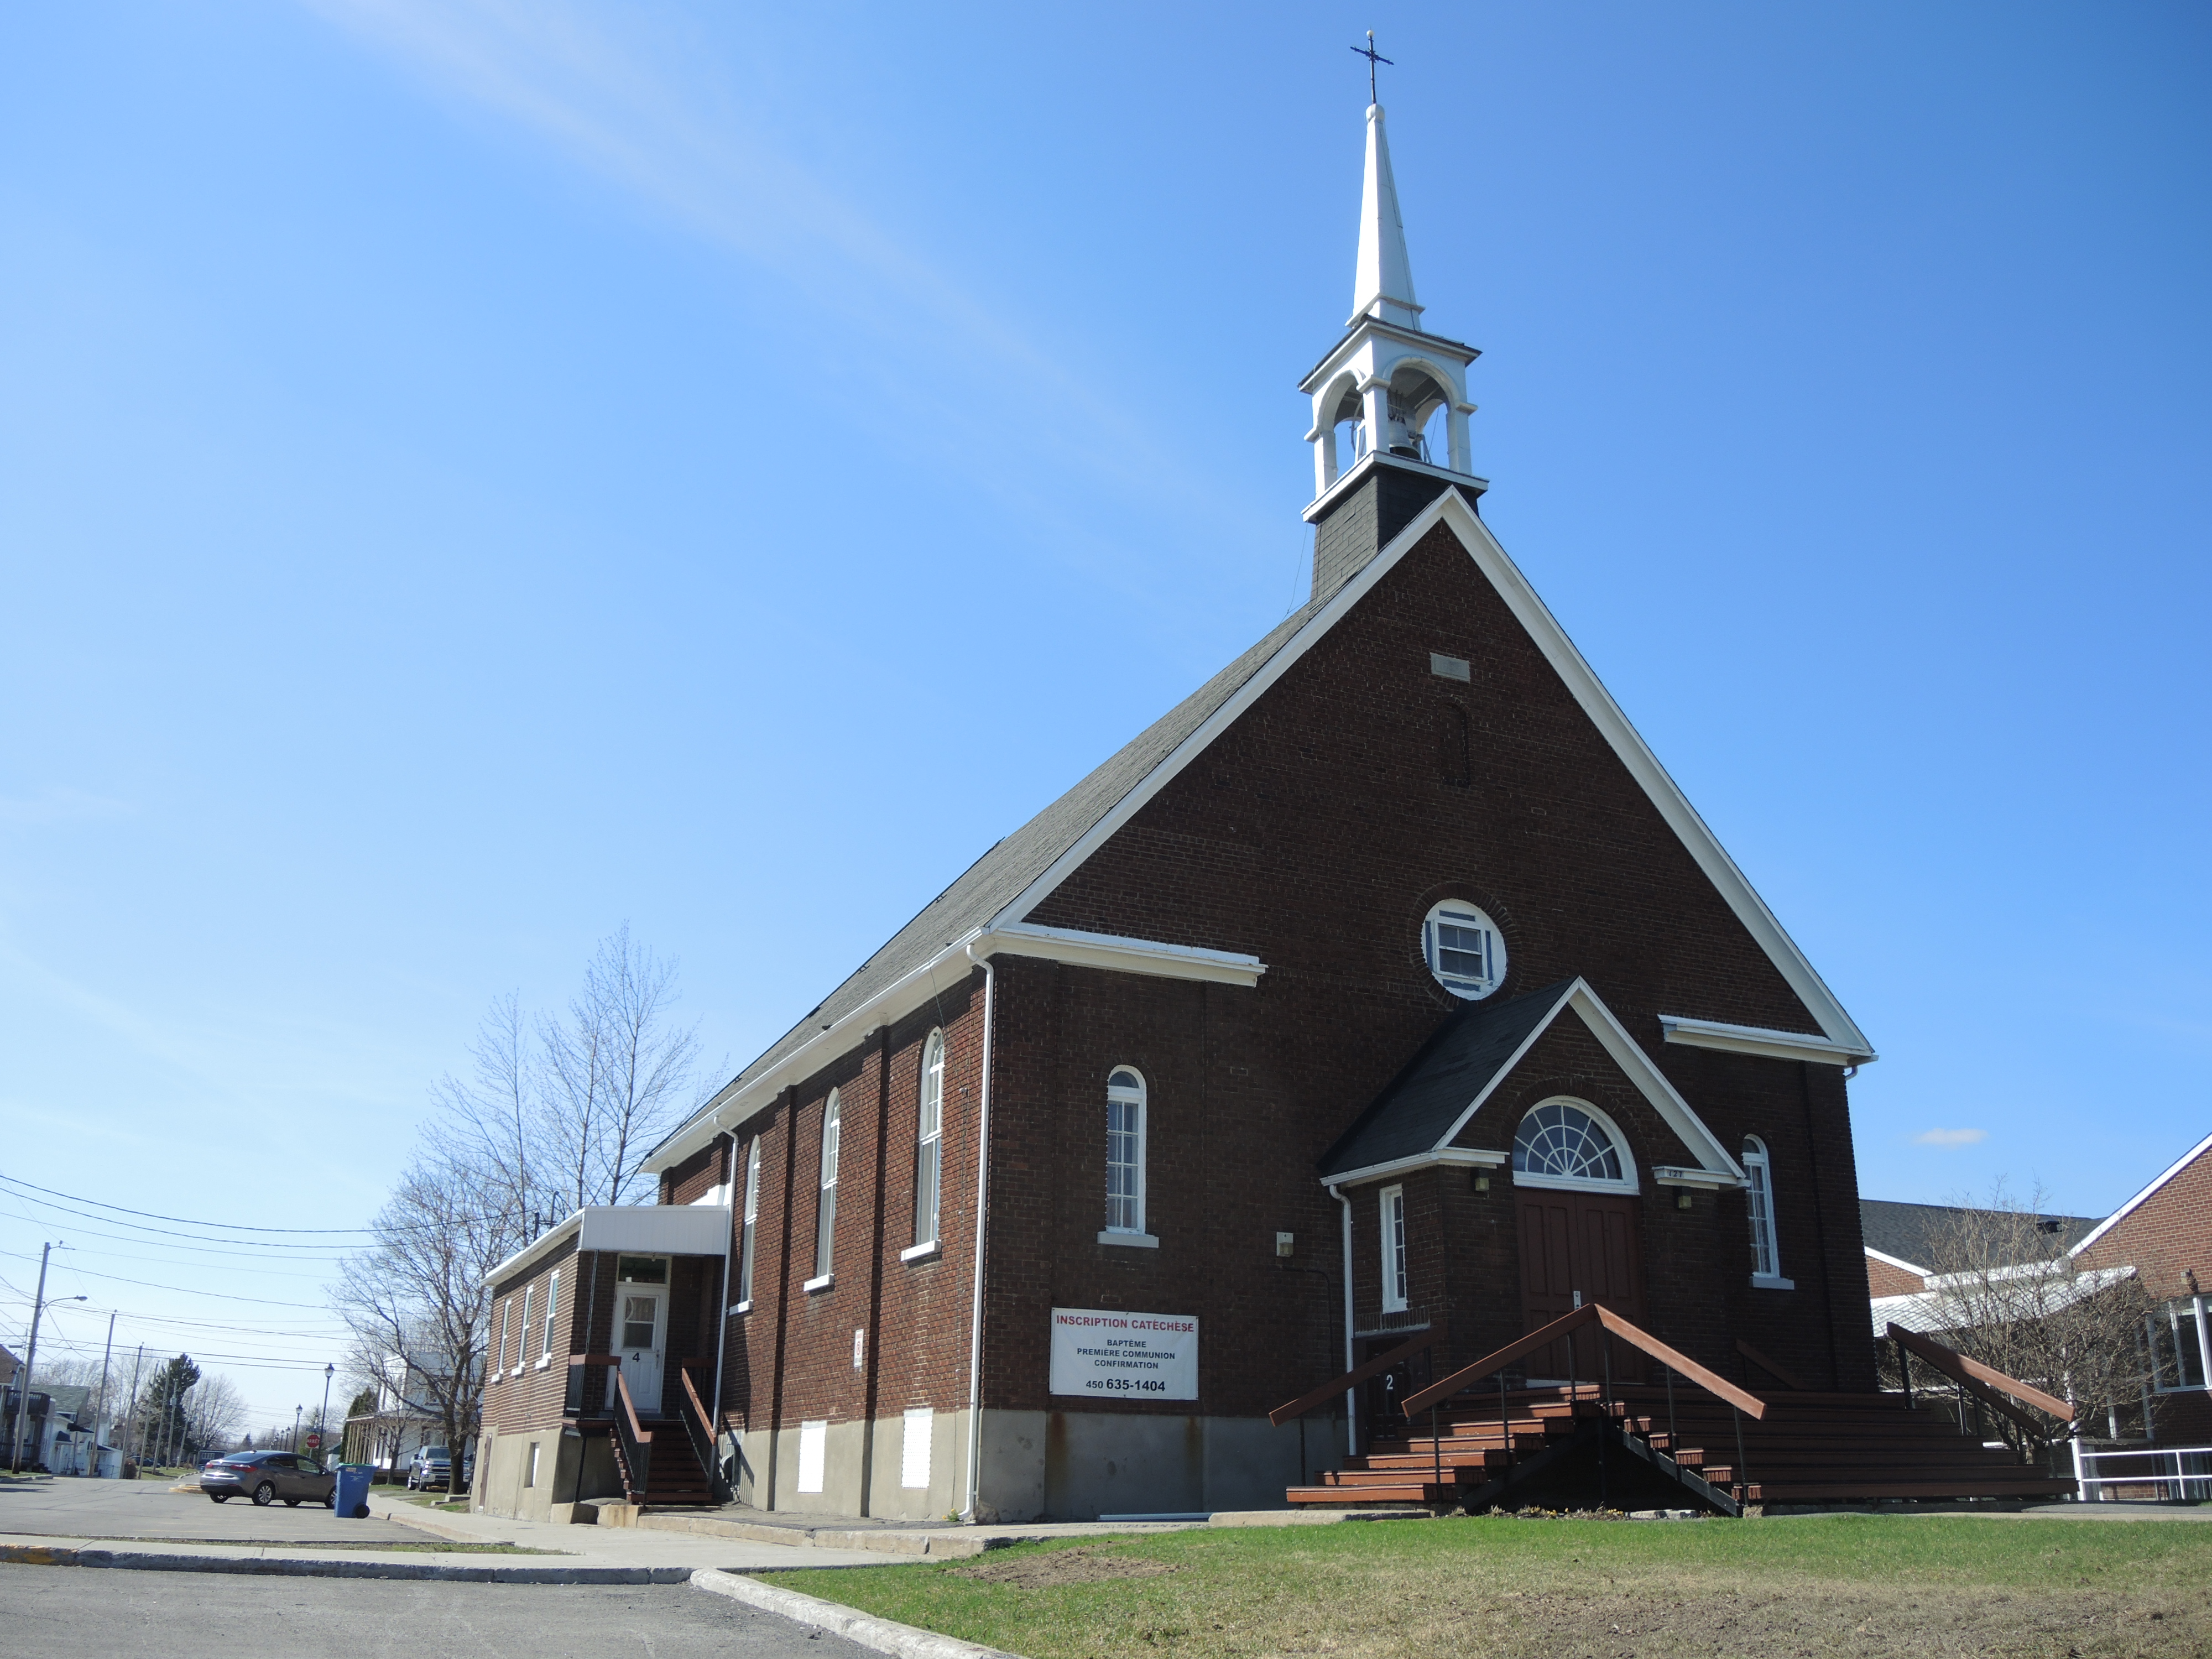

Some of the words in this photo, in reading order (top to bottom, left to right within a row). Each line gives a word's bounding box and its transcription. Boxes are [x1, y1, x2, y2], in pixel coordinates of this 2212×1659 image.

[1057, 1315, 1128, 1328] INSCRIPTION
[1131, 1319, 1194, 1332] CATÉCHÈSE
[1107, 1339, 1146, 1348] BAPTÊME
[632, 1352, 640, 1363] 4
[1123, 1350, 1175, 1359] COMMUNION
[1094, 1359, 1159, 1369] CONFIRMATION
[1086, 1380, 1103, 1389] 450
[1107, 1379, 1165, 1391] 635-1404
[1386, 1374, 1394, 1390] 2
